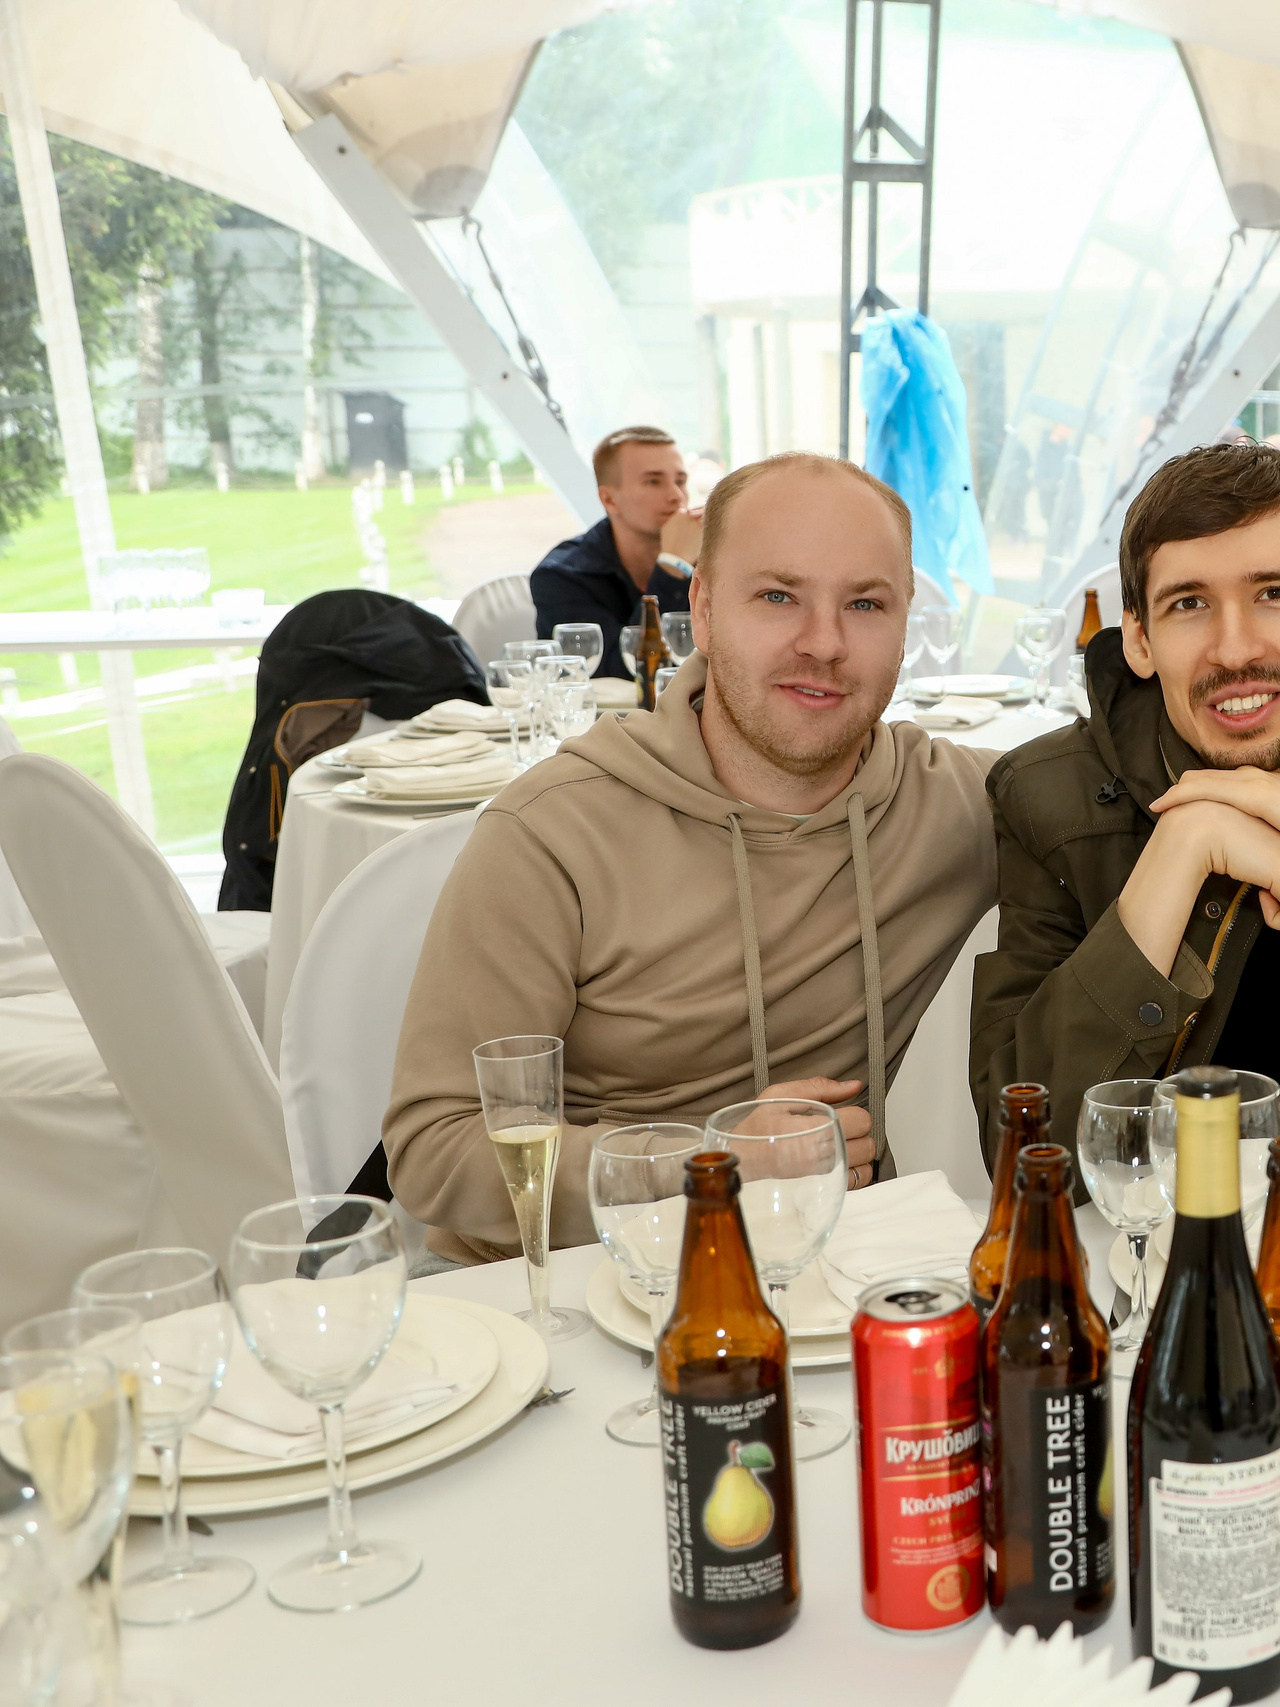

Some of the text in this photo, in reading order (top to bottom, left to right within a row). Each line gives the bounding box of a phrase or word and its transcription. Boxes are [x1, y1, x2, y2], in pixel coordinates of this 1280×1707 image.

[660, 1395, 684, 1593] DOUBLE TREE
[674, 1403, 695, 1598] natural premium craft cider
[691, 1403, 744, 1418] YELLOW
[1046, 1395, 1074, 1592] DOUBLE TREE
[1072, 1393, 1089, 1588] natural premium craft cider
